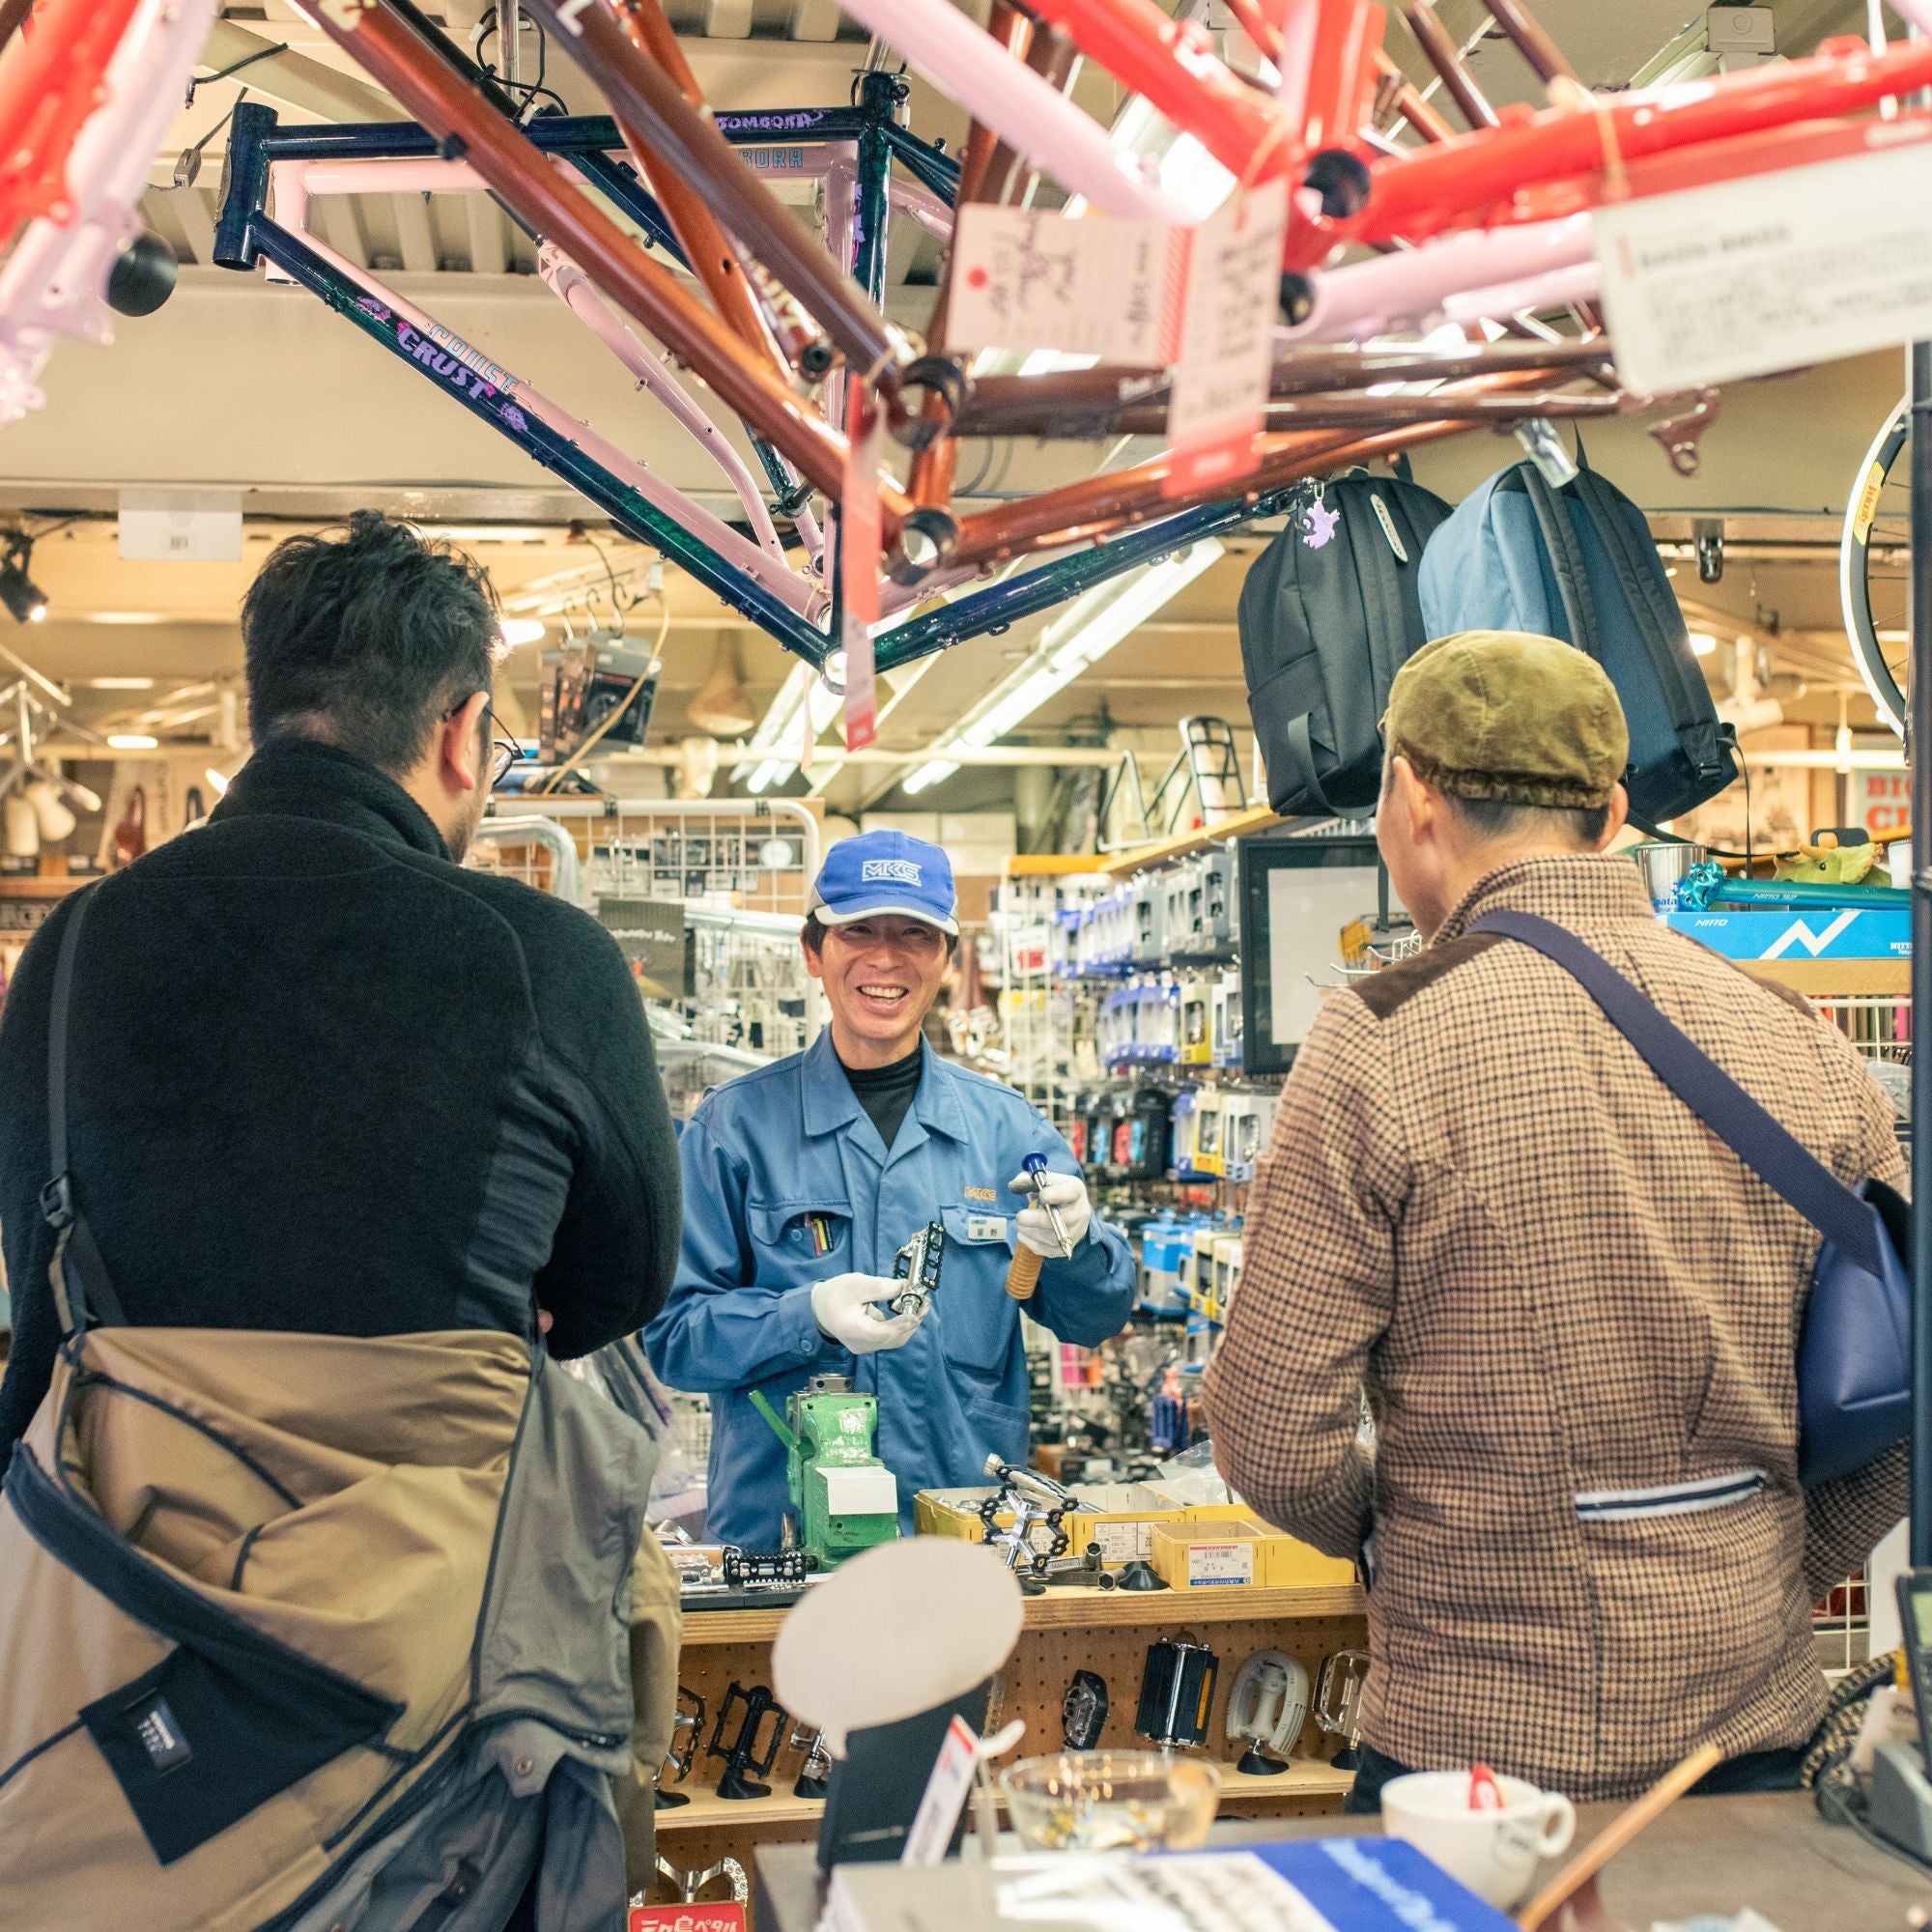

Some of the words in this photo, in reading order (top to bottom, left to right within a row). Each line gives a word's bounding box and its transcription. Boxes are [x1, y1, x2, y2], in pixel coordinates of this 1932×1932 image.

[397, 327, 491, 400] CRUST
[863, 860, 922, 887] MKS
[963, 1186, 997, 1202] MKS
